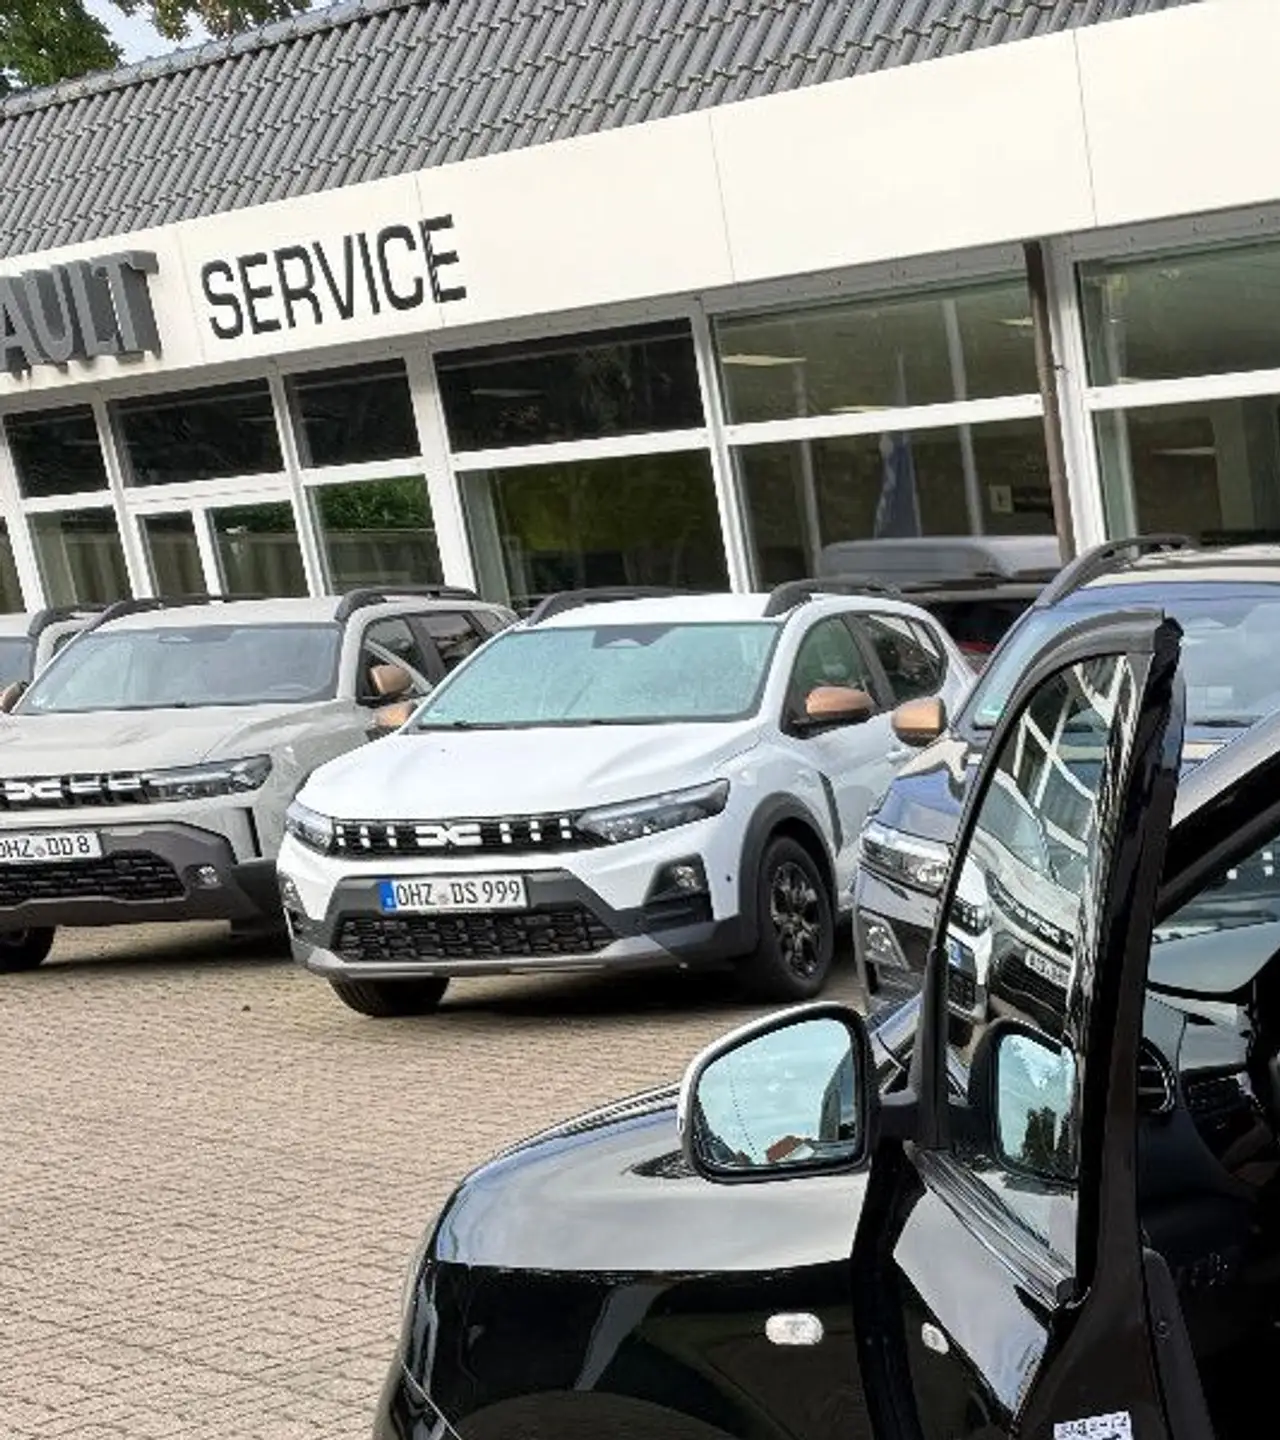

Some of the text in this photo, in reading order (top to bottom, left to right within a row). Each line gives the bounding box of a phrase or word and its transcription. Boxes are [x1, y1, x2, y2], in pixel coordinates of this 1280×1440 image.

[203, 213, 467, 340] SERVICE
[45, 837, 73, 856] DD
[77, 835, 91, 854] 8
[396, 883, 436, 906] OHZ
[451, 881, 478, 904] DS
[482, 880, 521, 903] 999
